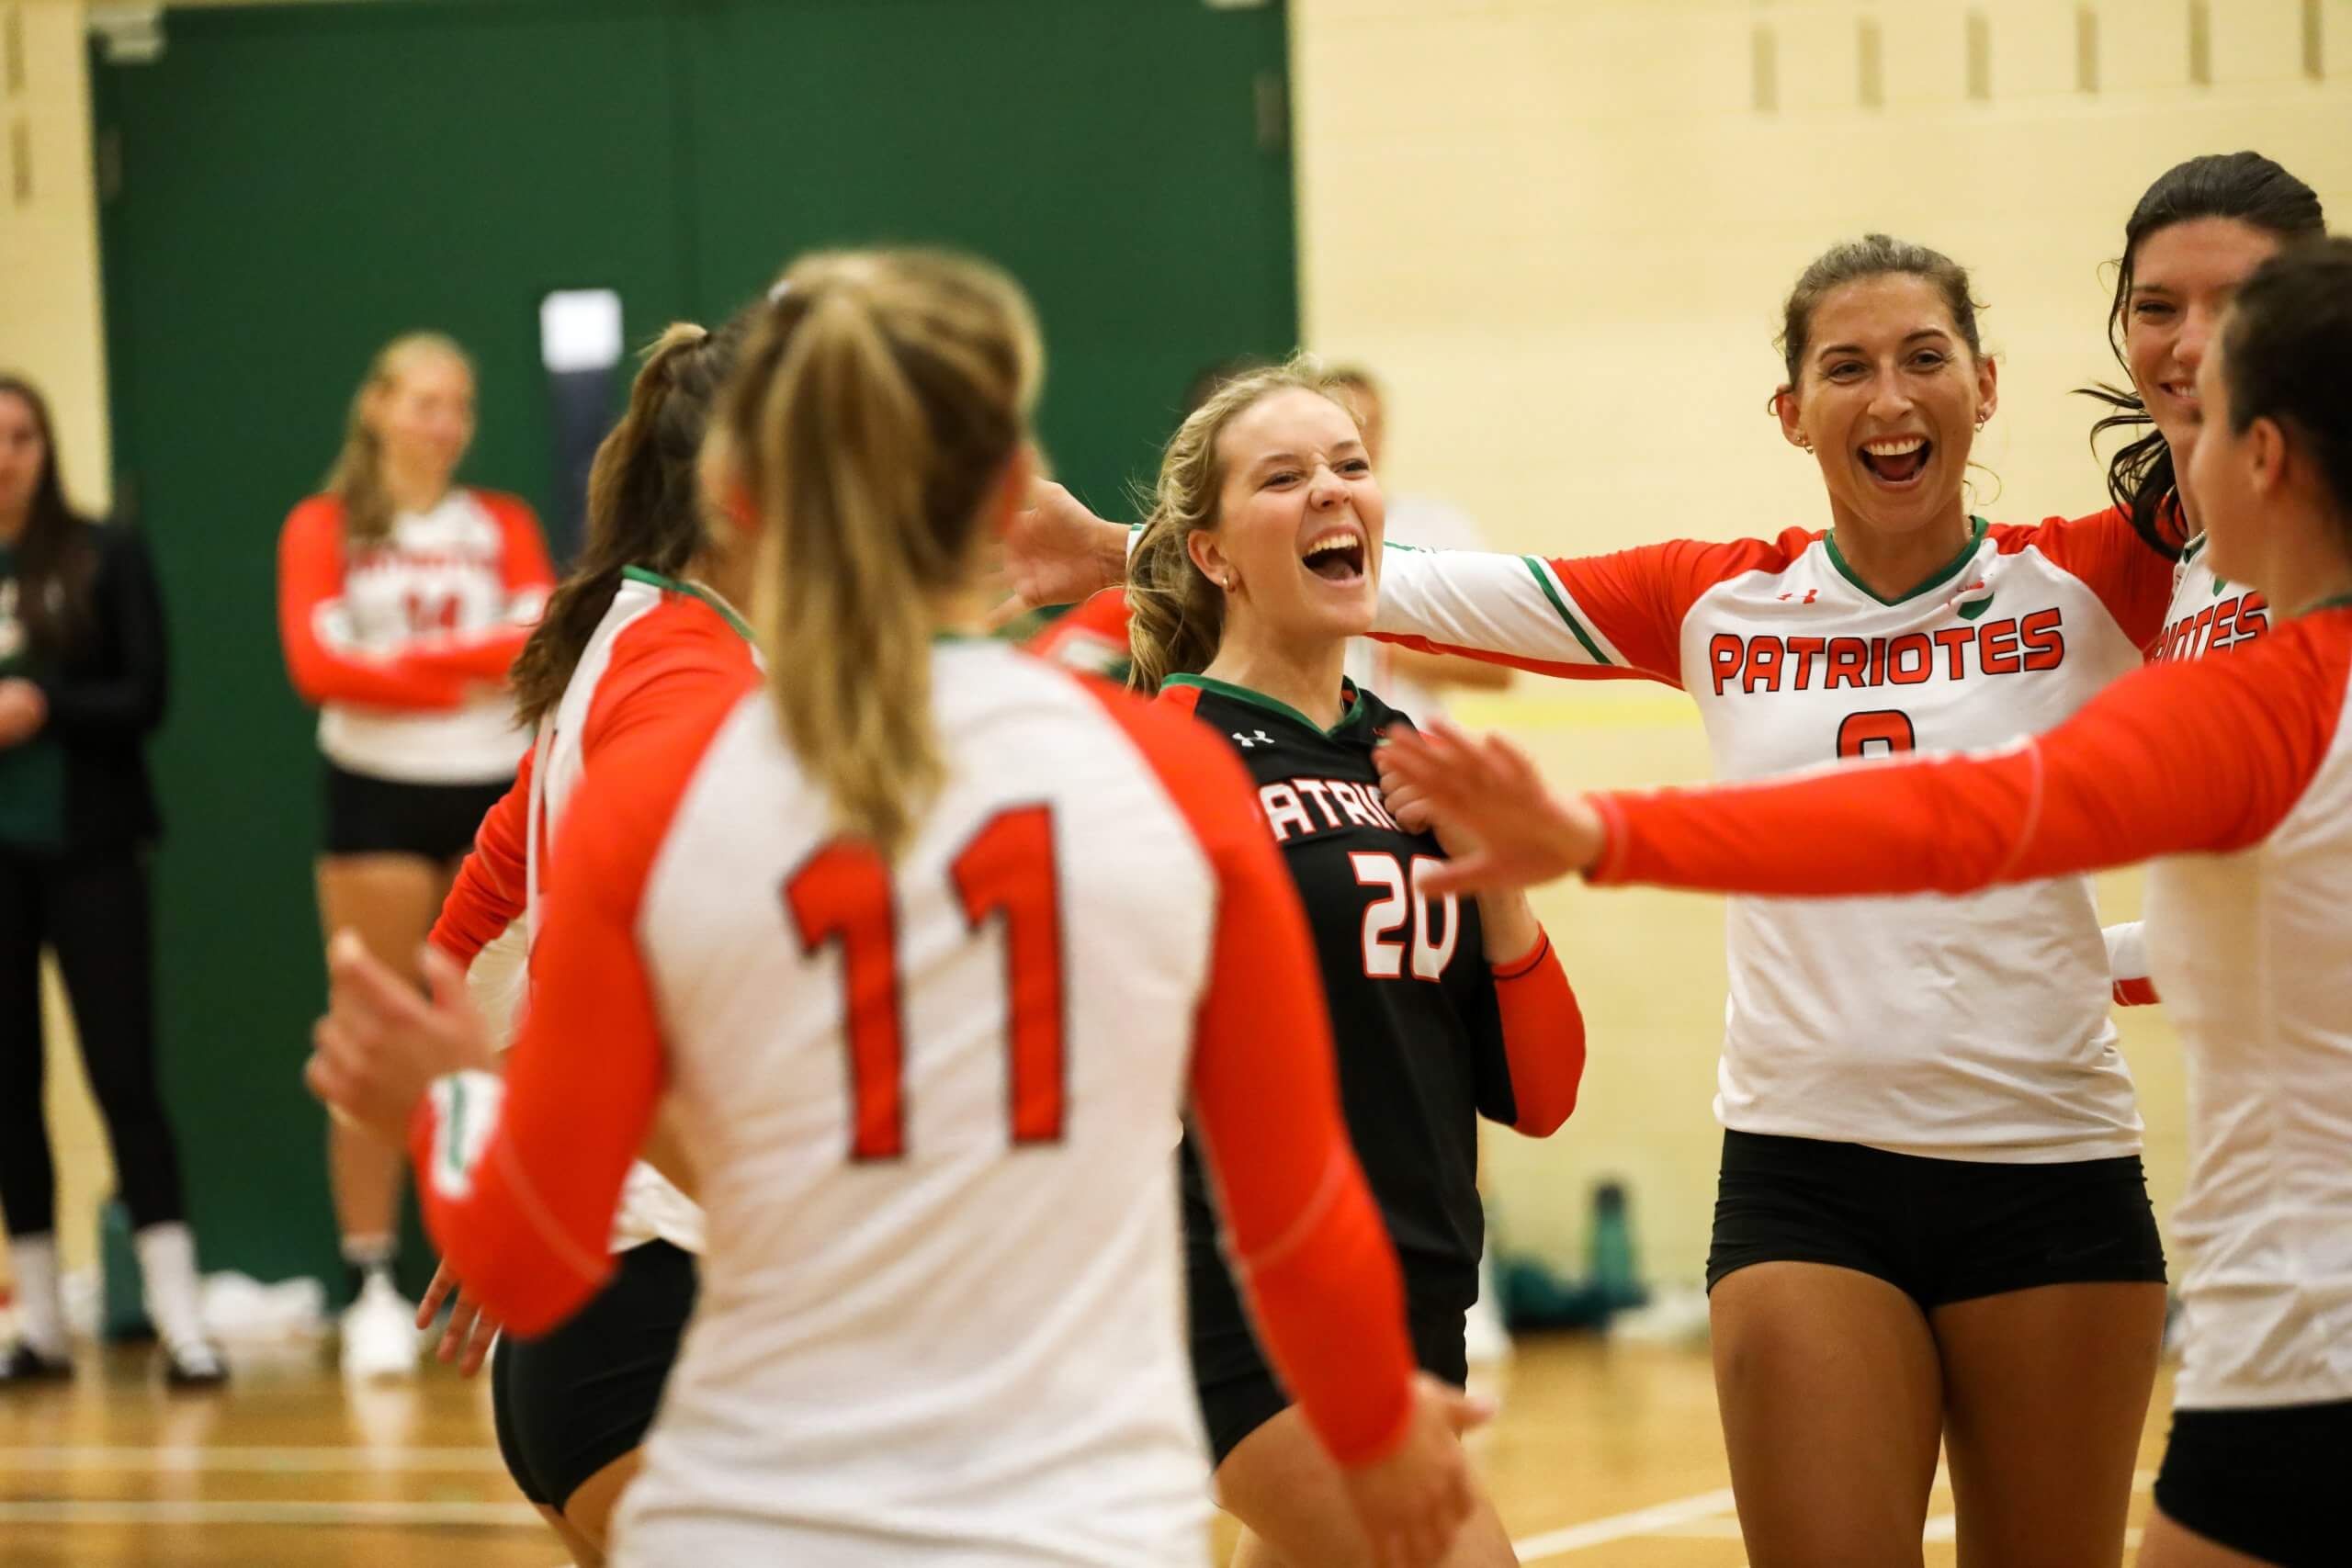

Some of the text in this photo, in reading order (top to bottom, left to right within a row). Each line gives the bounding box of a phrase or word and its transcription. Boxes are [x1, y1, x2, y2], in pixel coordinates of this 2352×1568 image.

[1710, 607, 2065, 695] PATRIOTES
[781, 801, 1066, 1163] 11
[1348, 852, 1460, 983] 20
